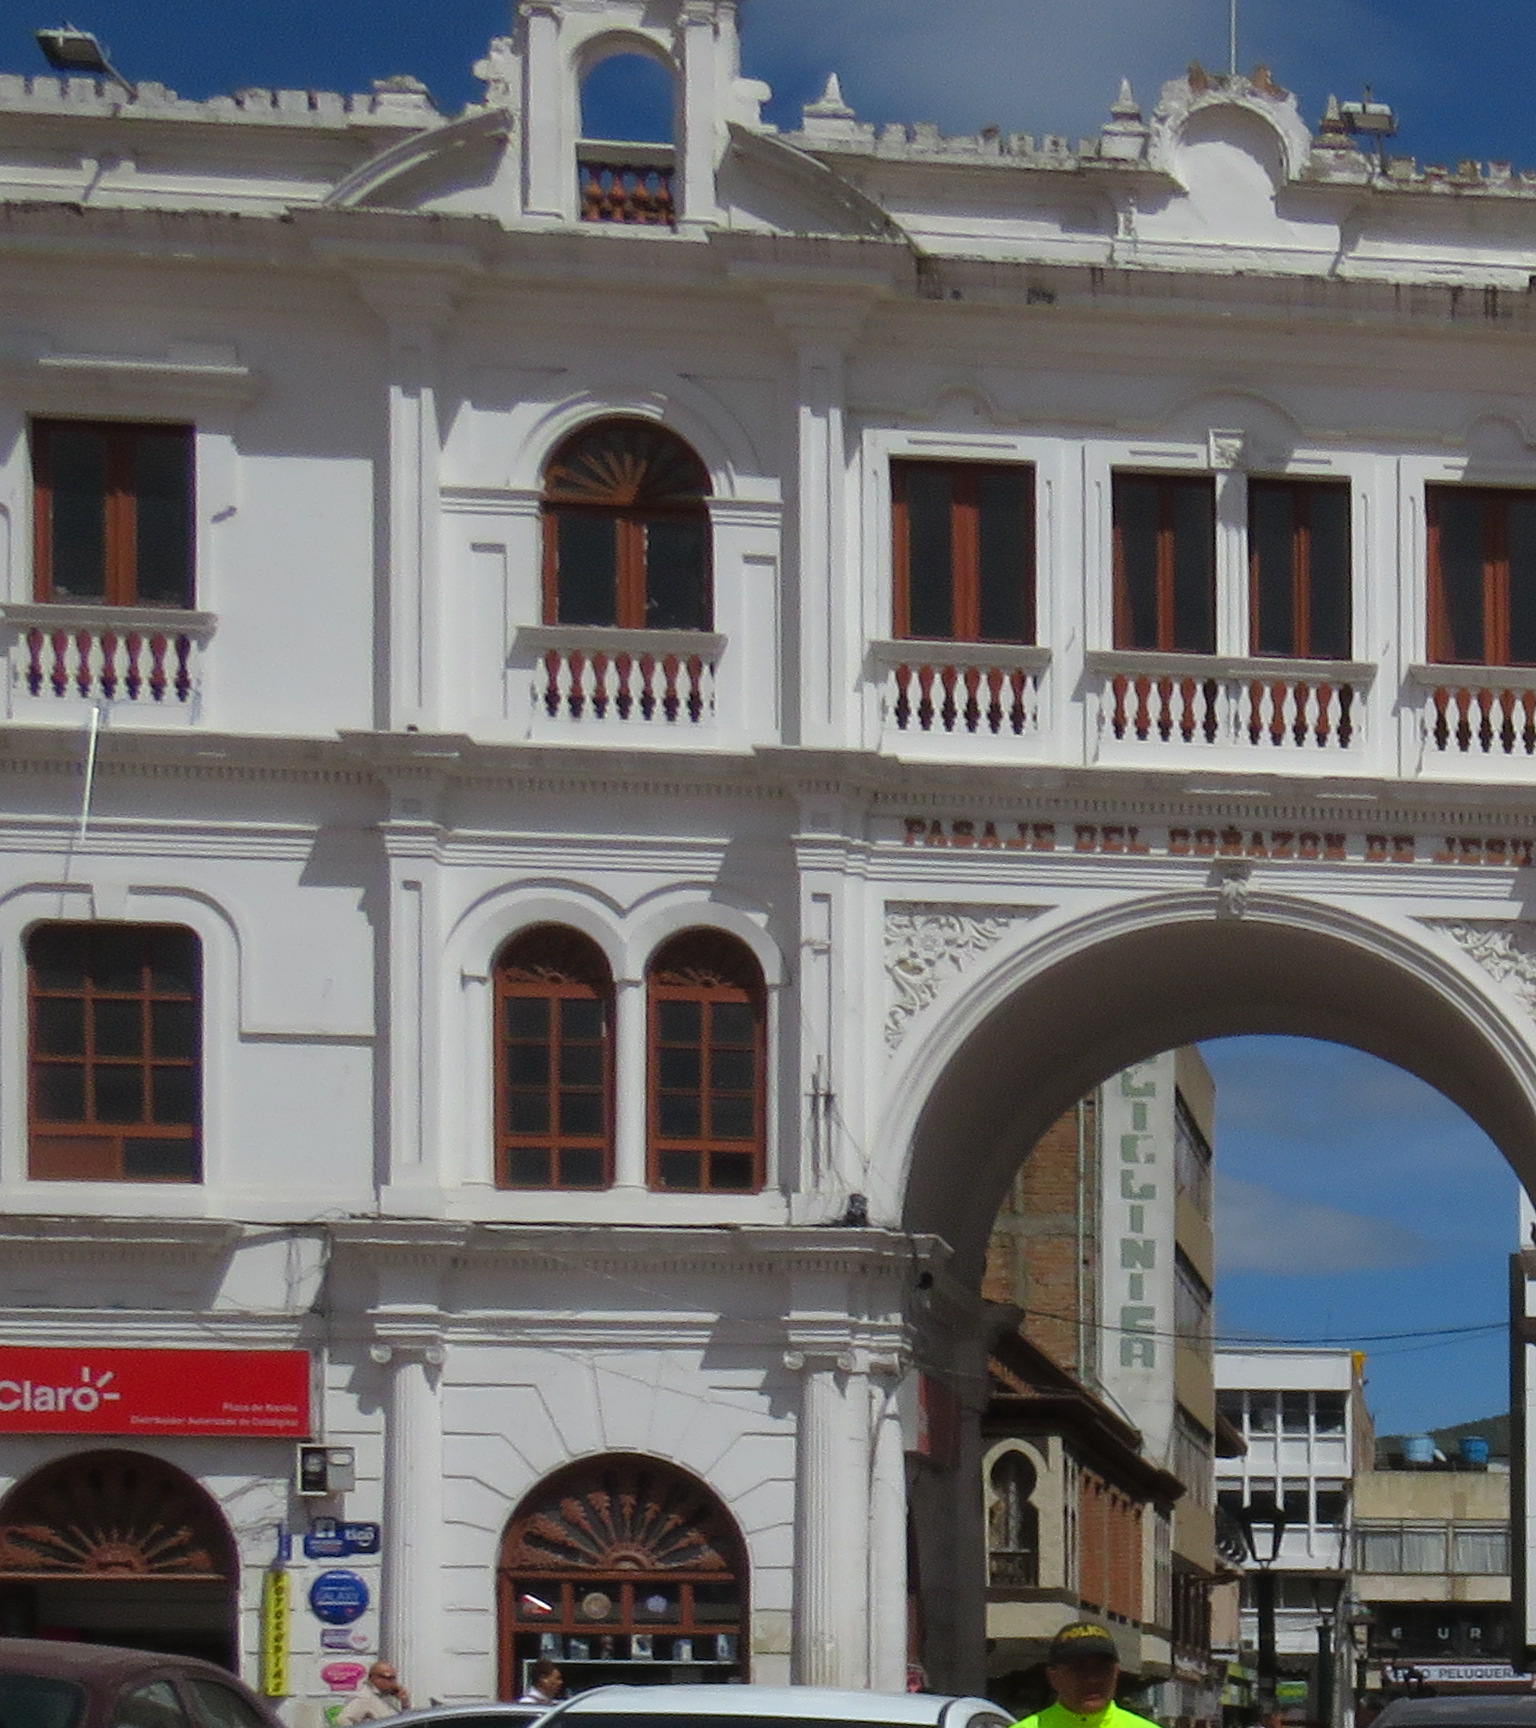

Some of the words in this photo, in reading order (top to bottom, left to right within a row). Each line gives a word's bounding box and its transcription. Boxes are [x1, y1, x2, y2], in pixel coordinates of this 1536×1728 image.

[903, 817, 1056, 849] PASAJE
[1073, 823, 1150, 854] DEL
[1365, 832, 1416, 862] DE
[1119, 1057, 1157, 1368] LICLINICA
[0, 1379, 99, 1412] Claro
